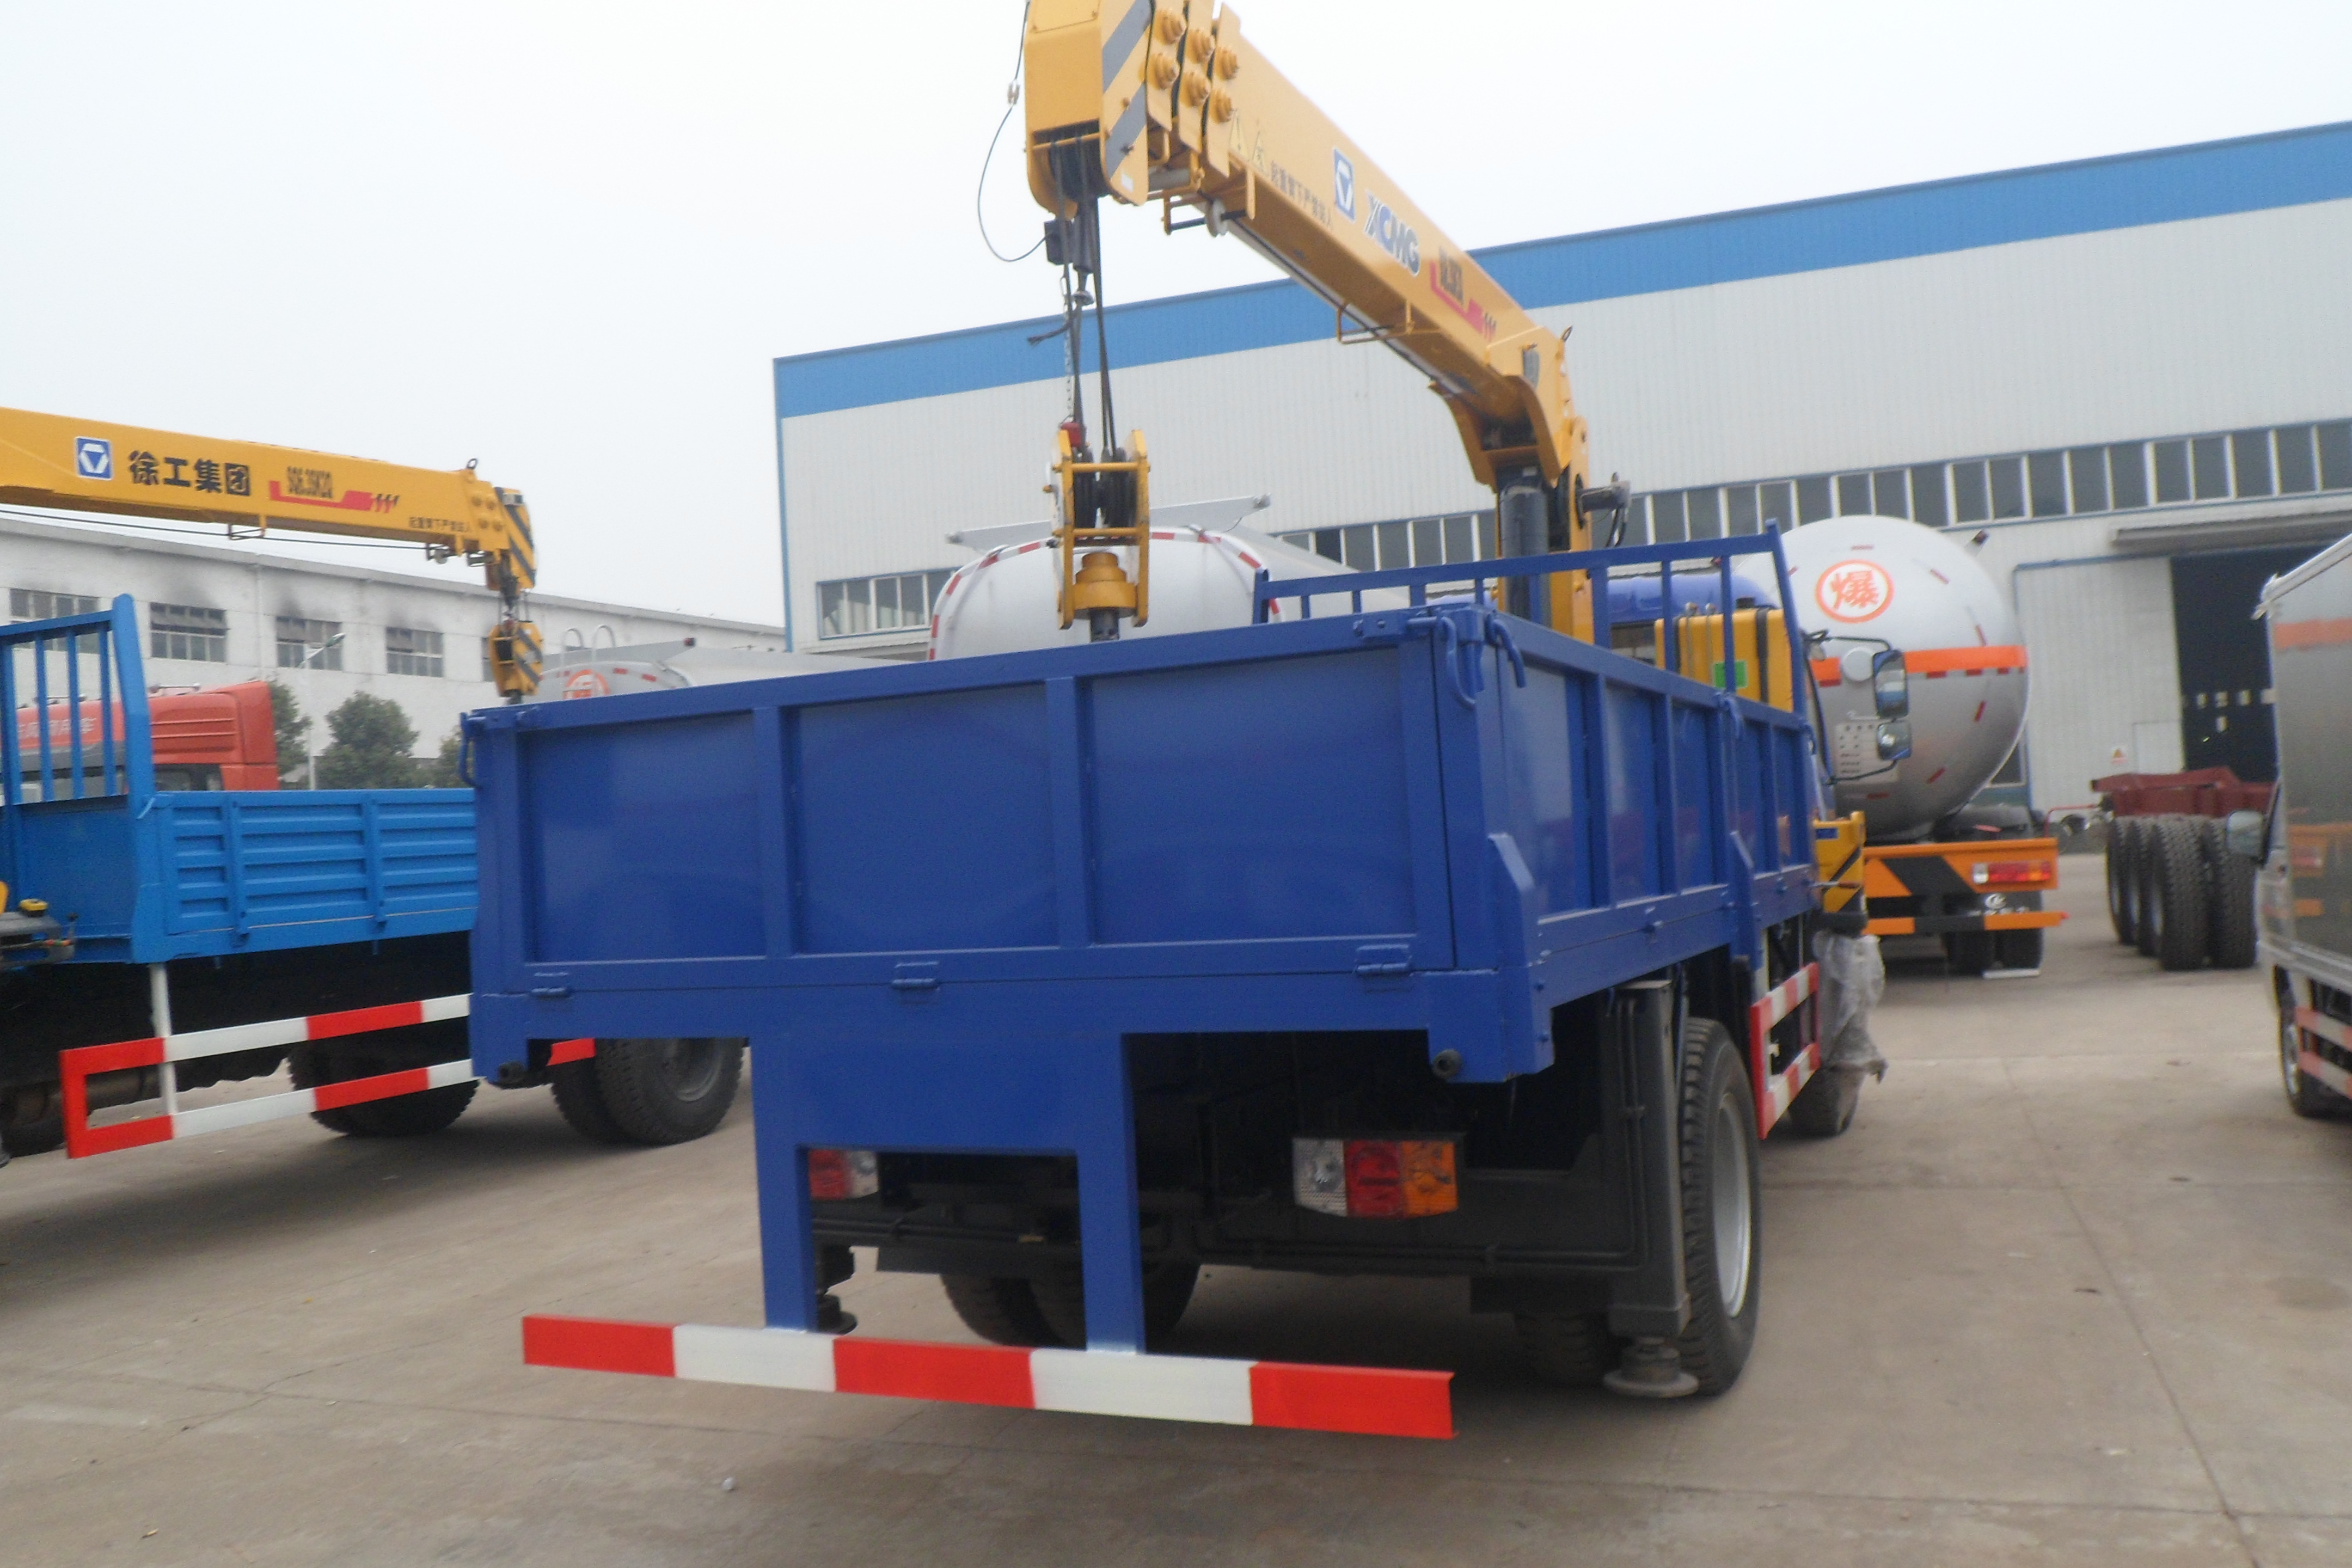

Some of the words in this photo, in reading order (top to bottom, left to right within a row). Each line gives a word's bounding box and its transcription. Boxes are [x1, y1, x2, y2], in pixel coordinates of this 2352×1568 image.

[1364, 191, 1420, 276] XCMG
[128, 449, 251, 496] 徐工集团
[1830, 569, 1879, 610] 爆
